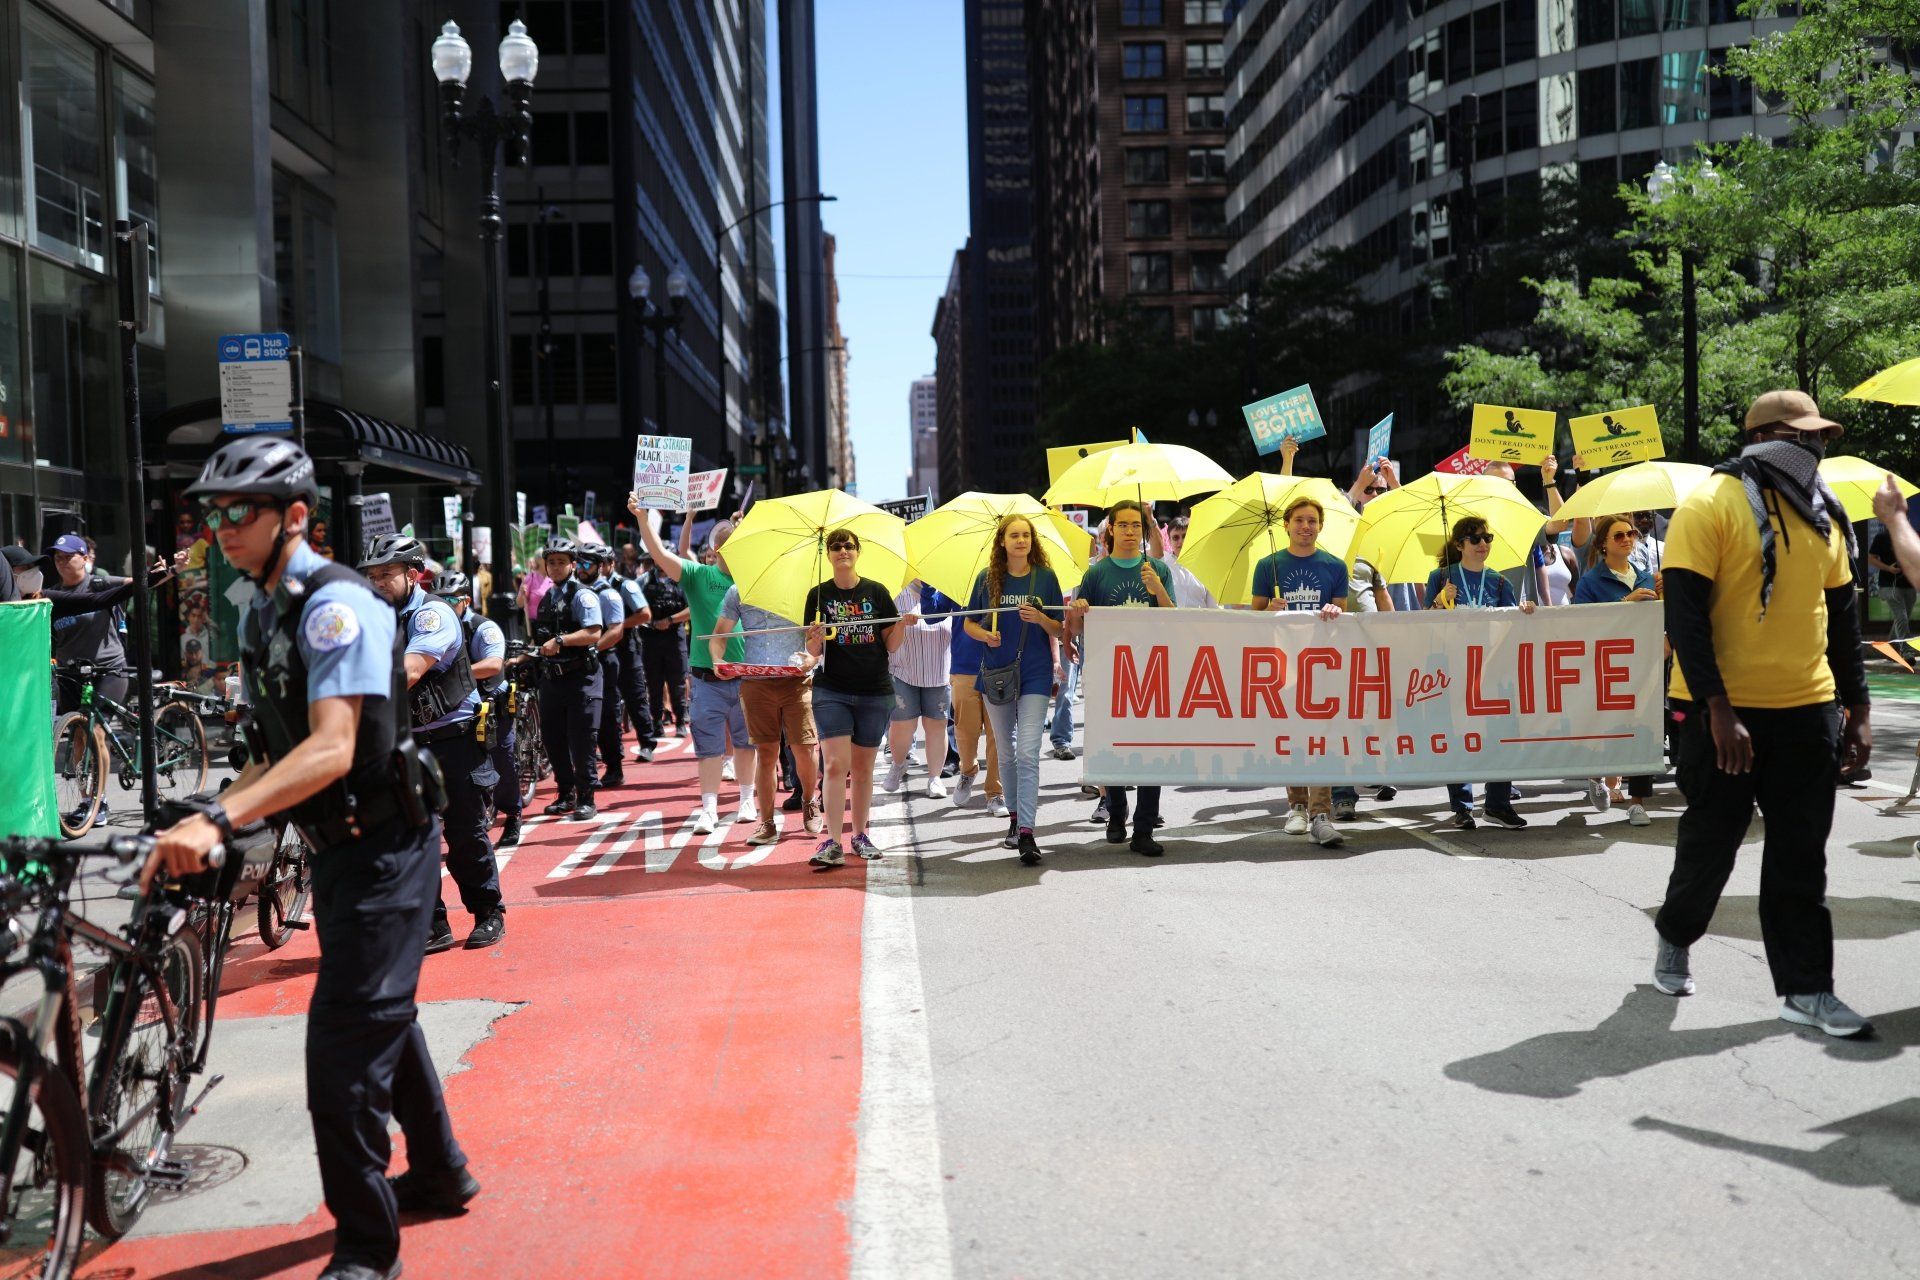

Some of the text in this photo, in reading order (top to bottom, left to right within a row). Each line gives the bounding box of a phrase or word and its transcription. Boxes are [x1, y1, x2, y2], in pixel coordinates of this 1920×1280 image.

[263, 337, 282, 347] bus
[225, 344, 239, 354] cta
[263, 347, 286, 359] stop
[1251, 393, 1309, 420] LOVE THEM
[1253, 403, 1315, 440] BOTH
[1474, 437, 1496, 445] DONT
[1498, 440, 1523, 448] TREAD
[1580, 447, 1602, 455] DONT
[1605, 443, 1631, 452] TREAD
[363, 506, 383, 516] THE
[904, 503, 925, 513] THE
[826, 601, 873, 616] WORLD
[837, 624, 874, 635] nything
[838, 634, 875, 644] BE KIND
[1111, 638, 1636, 719] MARCH for LIFE
[1275, 731, 1482, 756] CHICAGO
